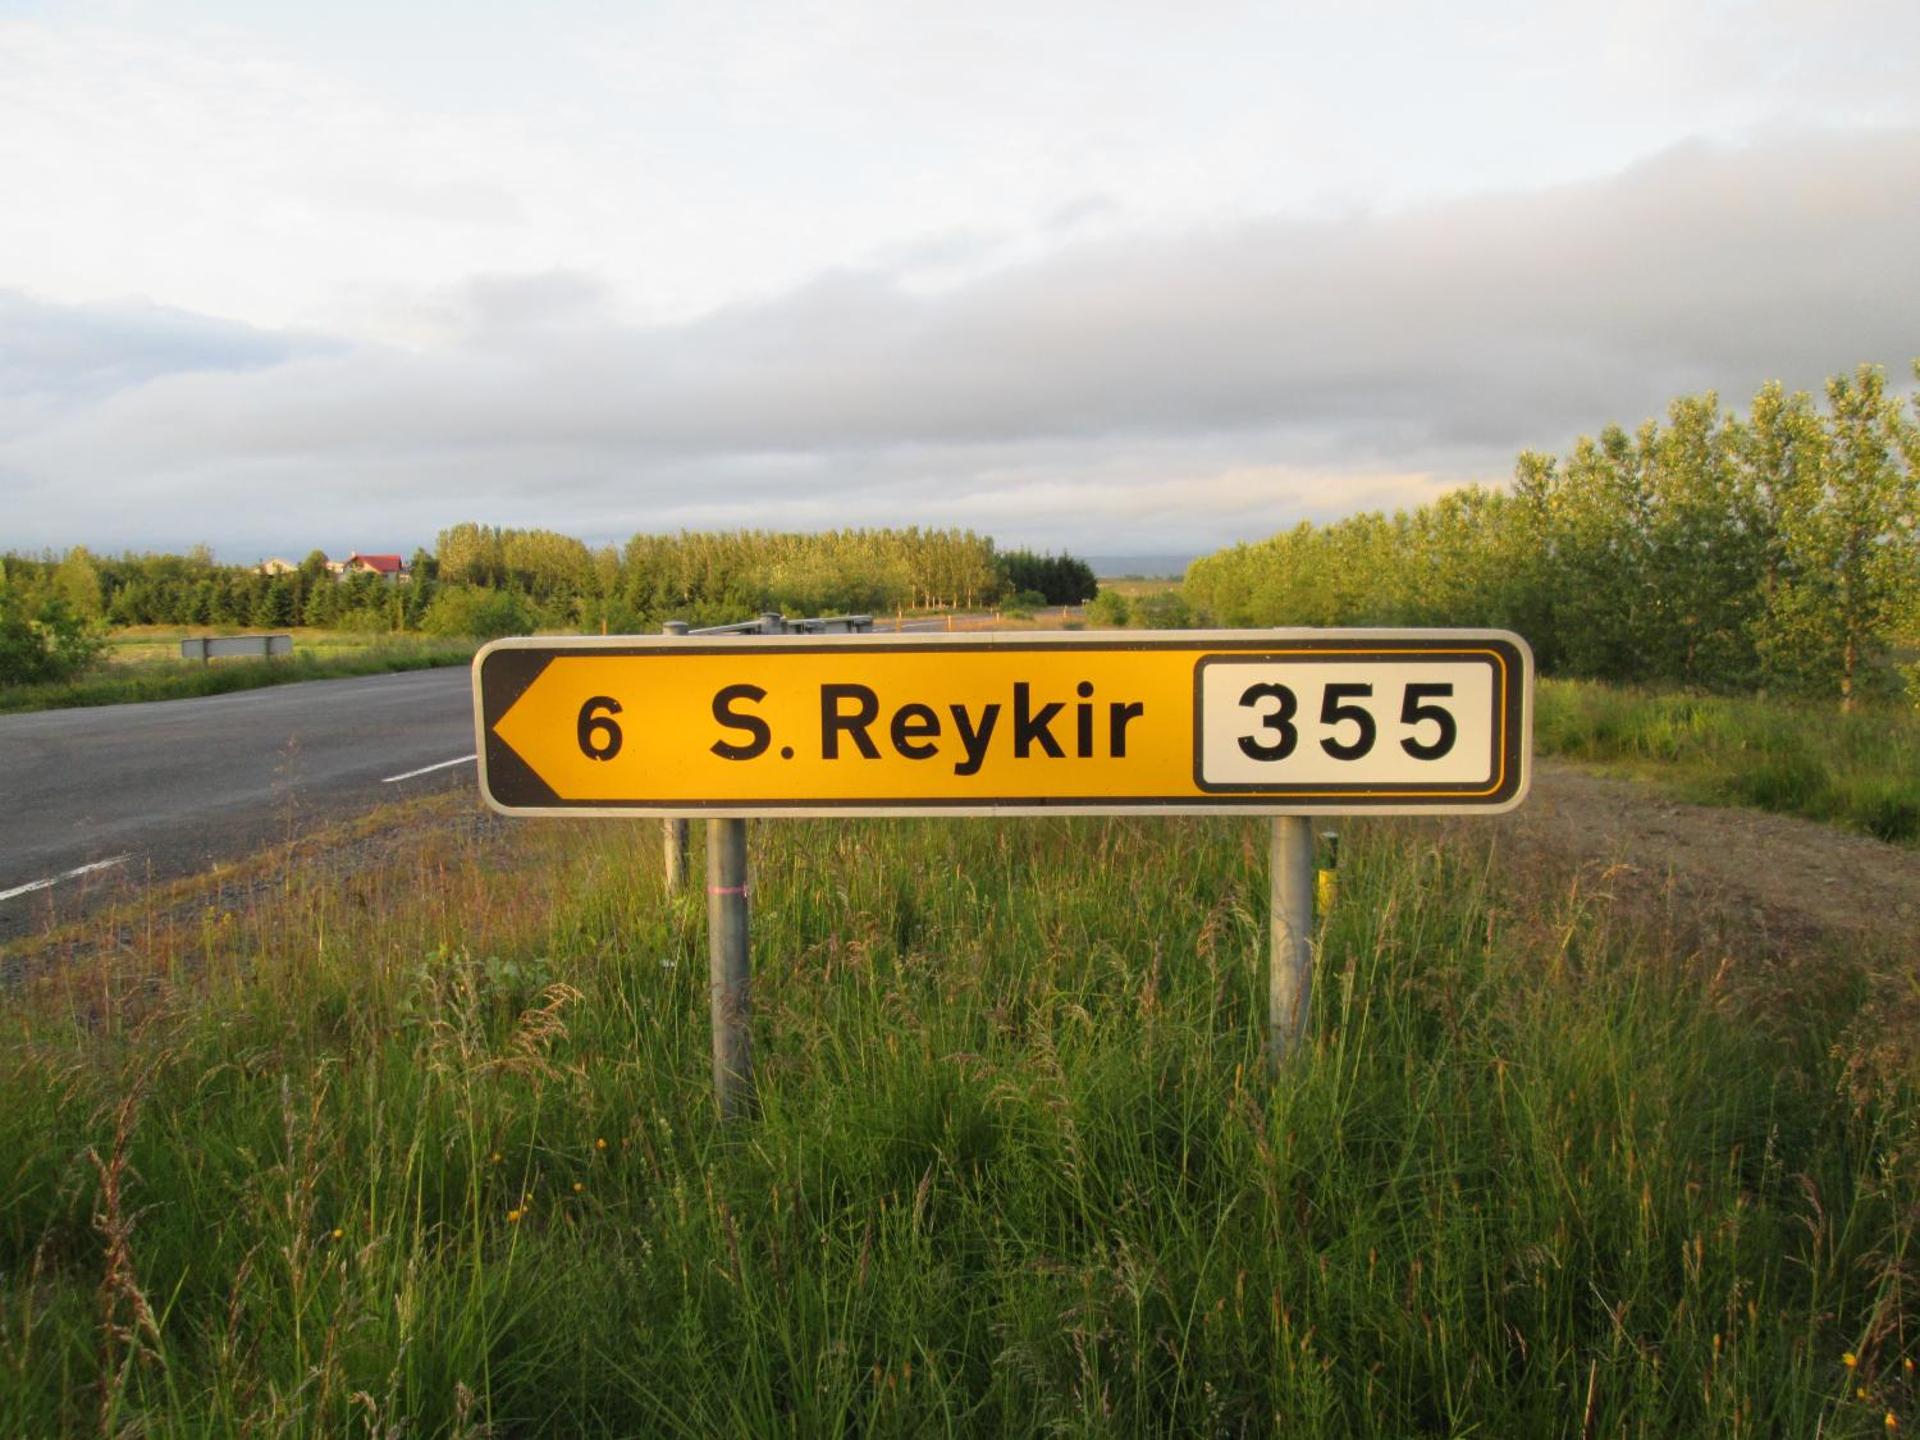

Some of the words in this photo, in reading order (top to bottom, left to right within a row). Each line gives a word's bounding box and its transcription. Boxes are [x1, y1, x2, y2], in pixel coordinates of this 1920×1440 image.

[576, 695, 623, 762] 6
[820, 681, 1145, 777] Reykir
[1236, 682, 1458, 763] 355
